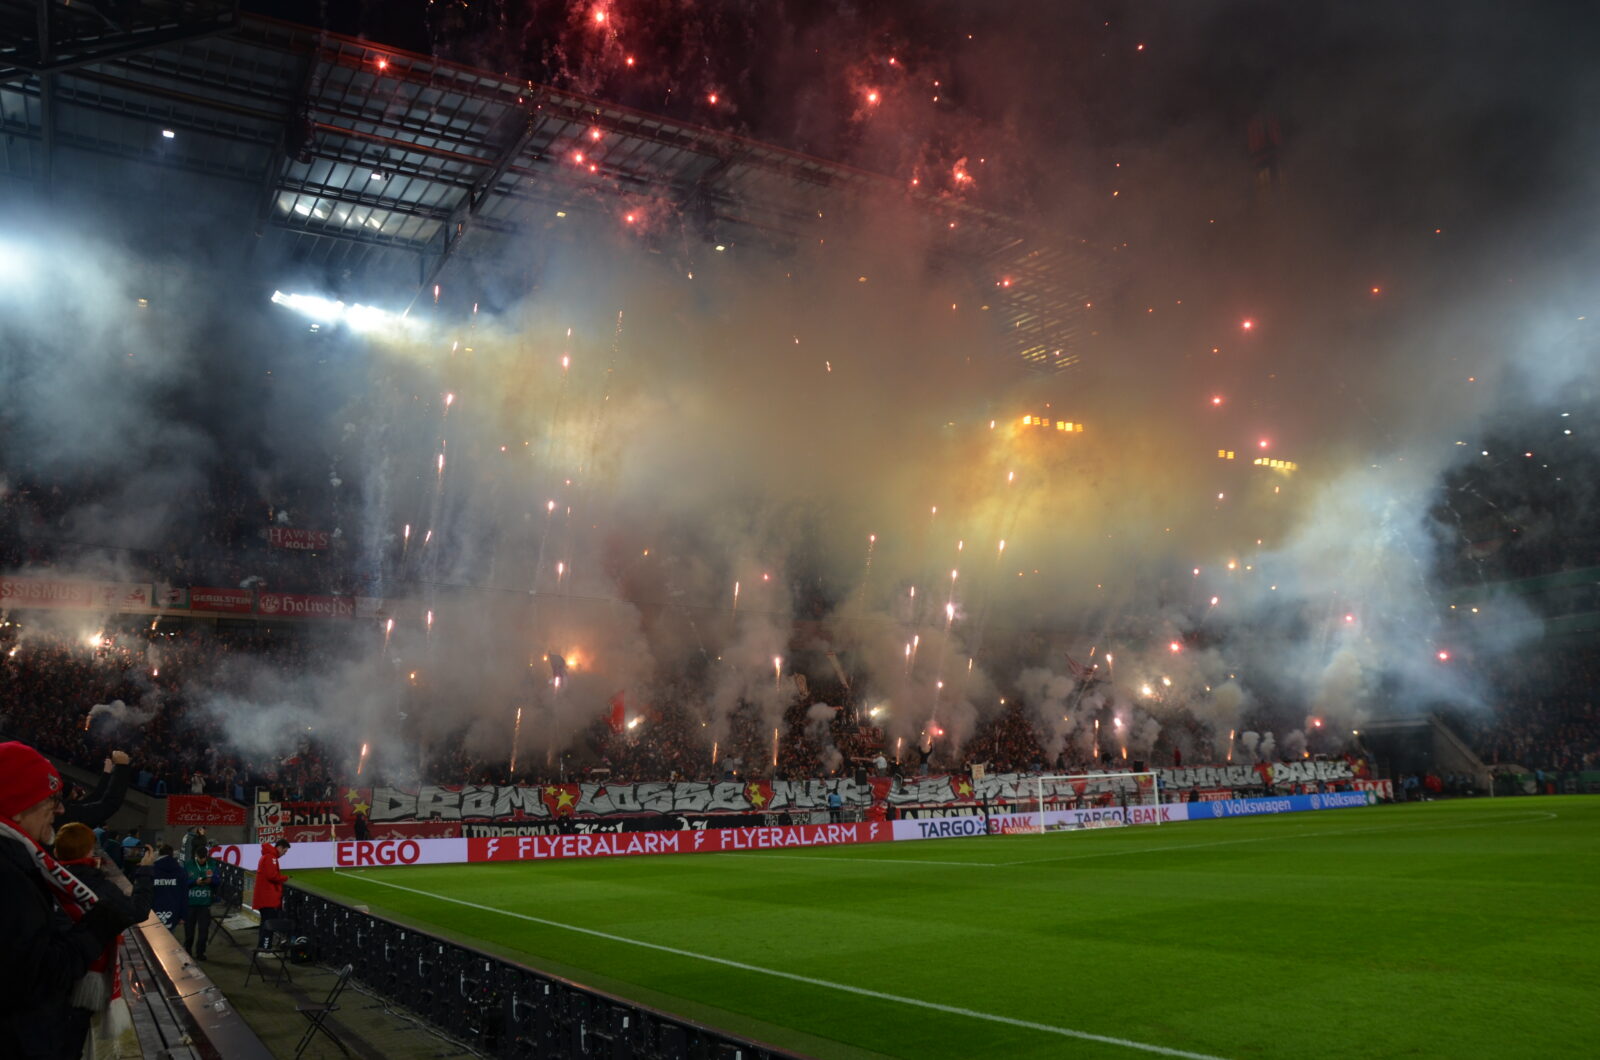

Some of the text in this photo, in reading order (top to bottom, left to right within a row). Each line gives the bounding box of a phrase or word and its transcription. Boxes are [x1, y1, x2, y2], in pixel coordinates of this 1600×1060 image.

[269, 528, 328, 547] HAWKS
[1225, 798, 1291, 815] Volkswagen
[518, 831, 679, 858] FLYERALARM
[720, 824, 857, 849] FLYERALARM
[337, 840, 420, 866] ERGO
[153, 878, 176, 886] REWE
